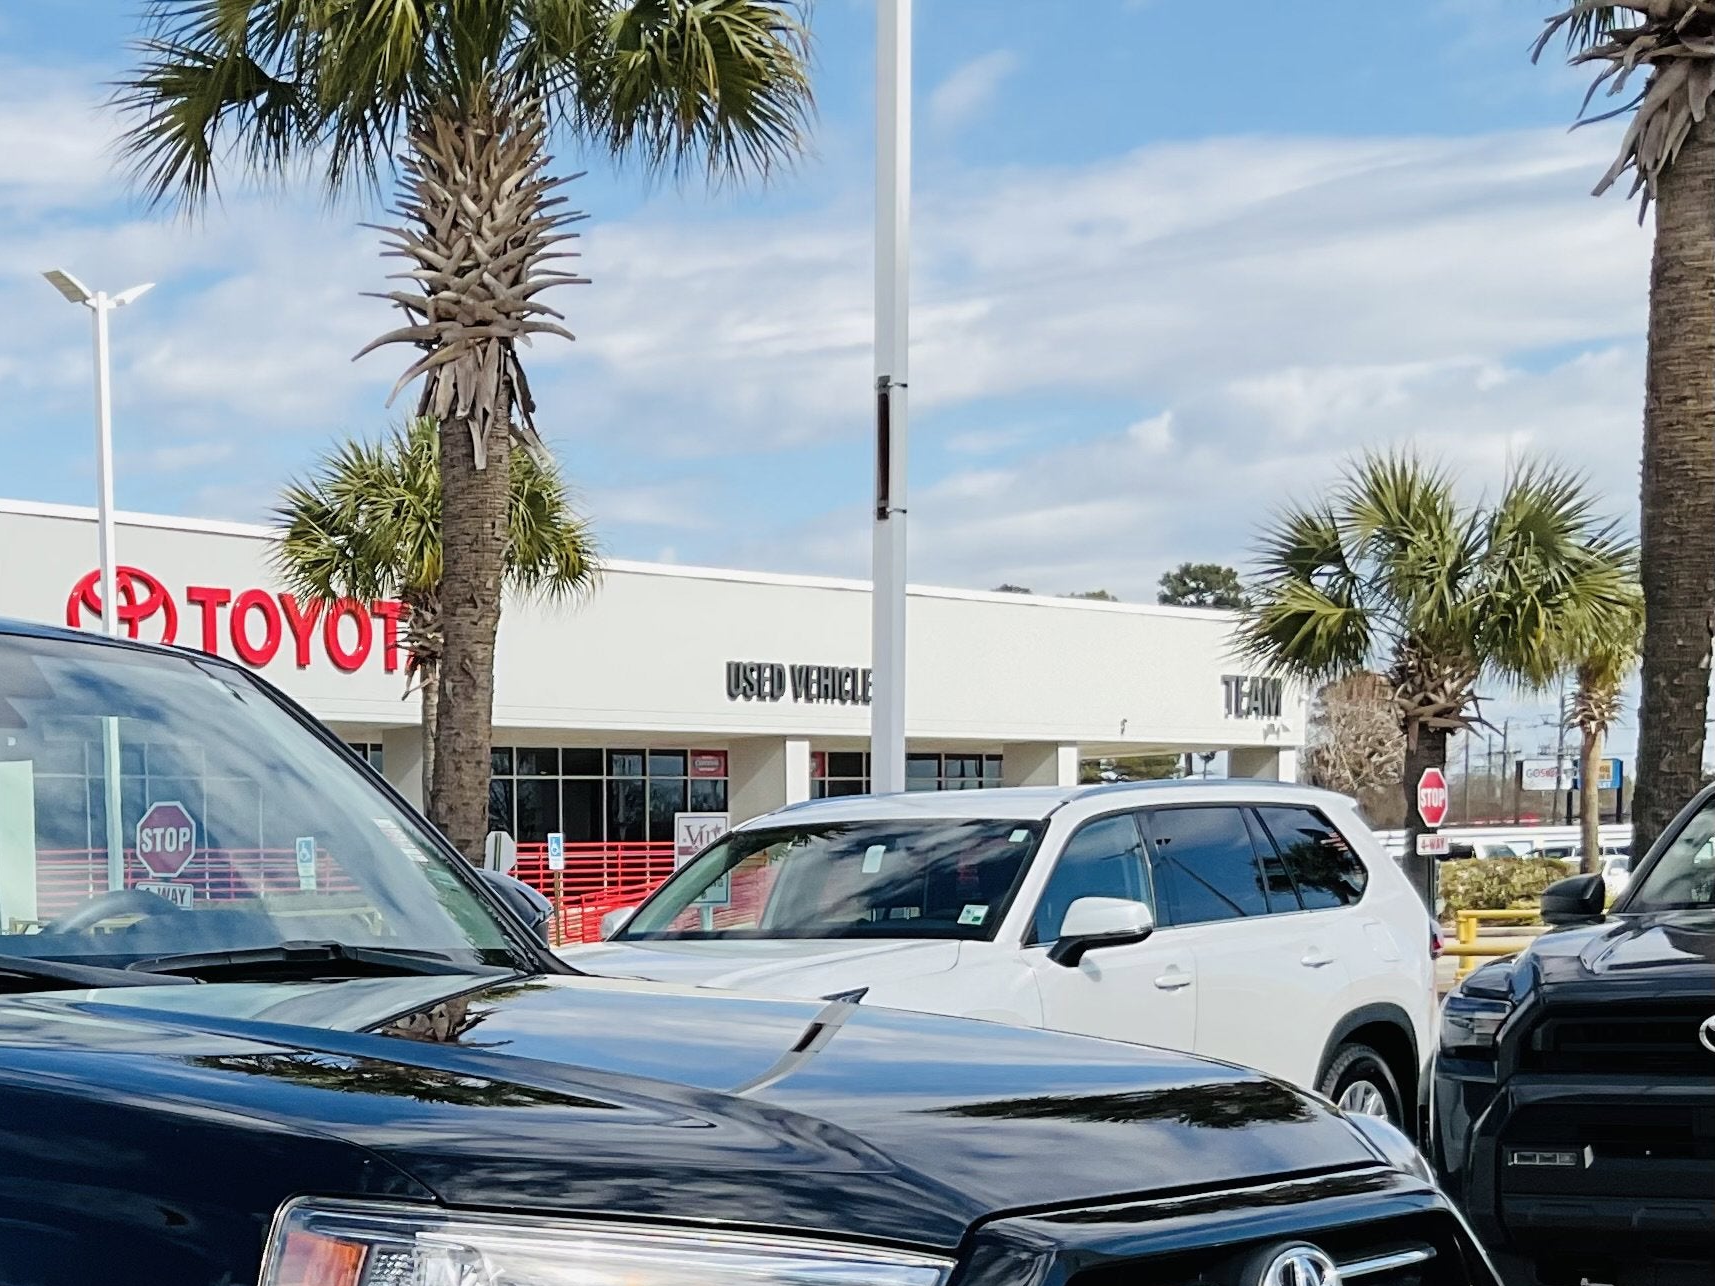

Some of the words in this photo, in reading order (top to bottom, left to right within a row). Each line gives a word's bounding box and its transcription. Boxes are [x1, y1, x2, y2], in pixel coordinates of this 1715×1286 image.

[187, 586, 420, 673] TOYOT
[726, 661, 786, 702] USED
[1221, 675, 1282, 720] TEAM
[1420, 788, 1445, 808] STOP
[141, 827, 191, 853] STOP
[1420, 837, 1445, 850] 4-WAY
[144, 887, 188, 905] WAY
